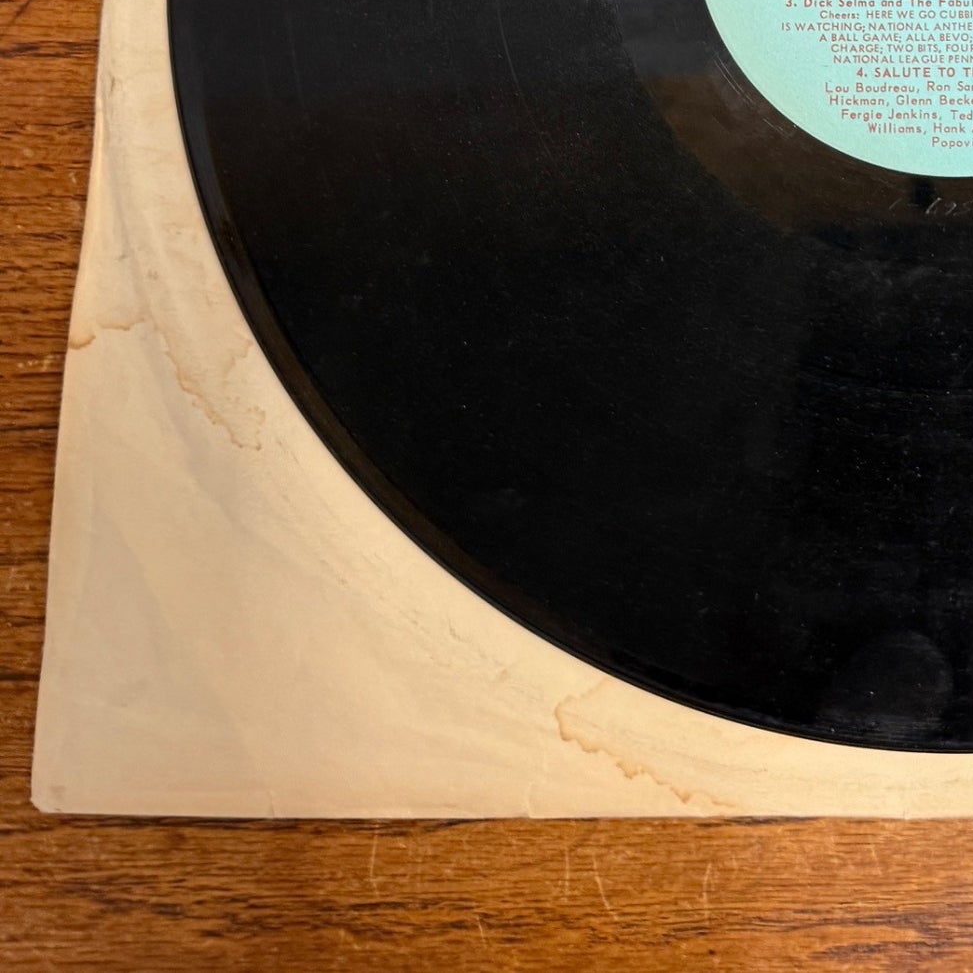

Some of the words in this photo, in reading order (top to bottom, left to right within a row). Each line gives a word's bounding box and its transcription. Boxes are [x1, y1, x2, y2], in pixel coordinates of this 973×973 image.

[820, 10, 860, 19] Cheers:
[866, 10, 893, 19] HERE
[897, 10, 914, 19] WE
[919, 10, 936, 19] GO
[782, 22, 791, 31] IS
[795, 22, 865, 33] WATCHING;
[868, 22, 929, 31] NATIONAL
[819, 34, 827, 42] A
[831, 33, 858, 42] BALL
[862, 32, 901, 43] GAME;
[906, 33, 935, 42] ALLA
[939, 33, 973, 43] BEVO;
[831, 44, 883, 54] CHARGE;
[887, 44, 913, 52] TWO
[918, 44, 941, 54] BITS,
[833, 55, 894, 64] NATIONAL
[899, 55, 944, 64] LEAGUE
[856, 67, 867, 77] 4.
[874, 67, 931, 78] SALUTE
[937, 67, 955, 77] TO
[825, 82, 849, 94] Lou
[856, 82, 919, 93] Boudreau,
[927, 81, 950, 91] Ron
[830, 95, 889, 107] Hickman,
[896, 95, 932, 105] Glenn
[841, 109, 882, 122] Fergie
[950, 110, 973, 120] Ted
[868, 121, 926, 135] Williams,
[933, 122, 965, 133] Hank
